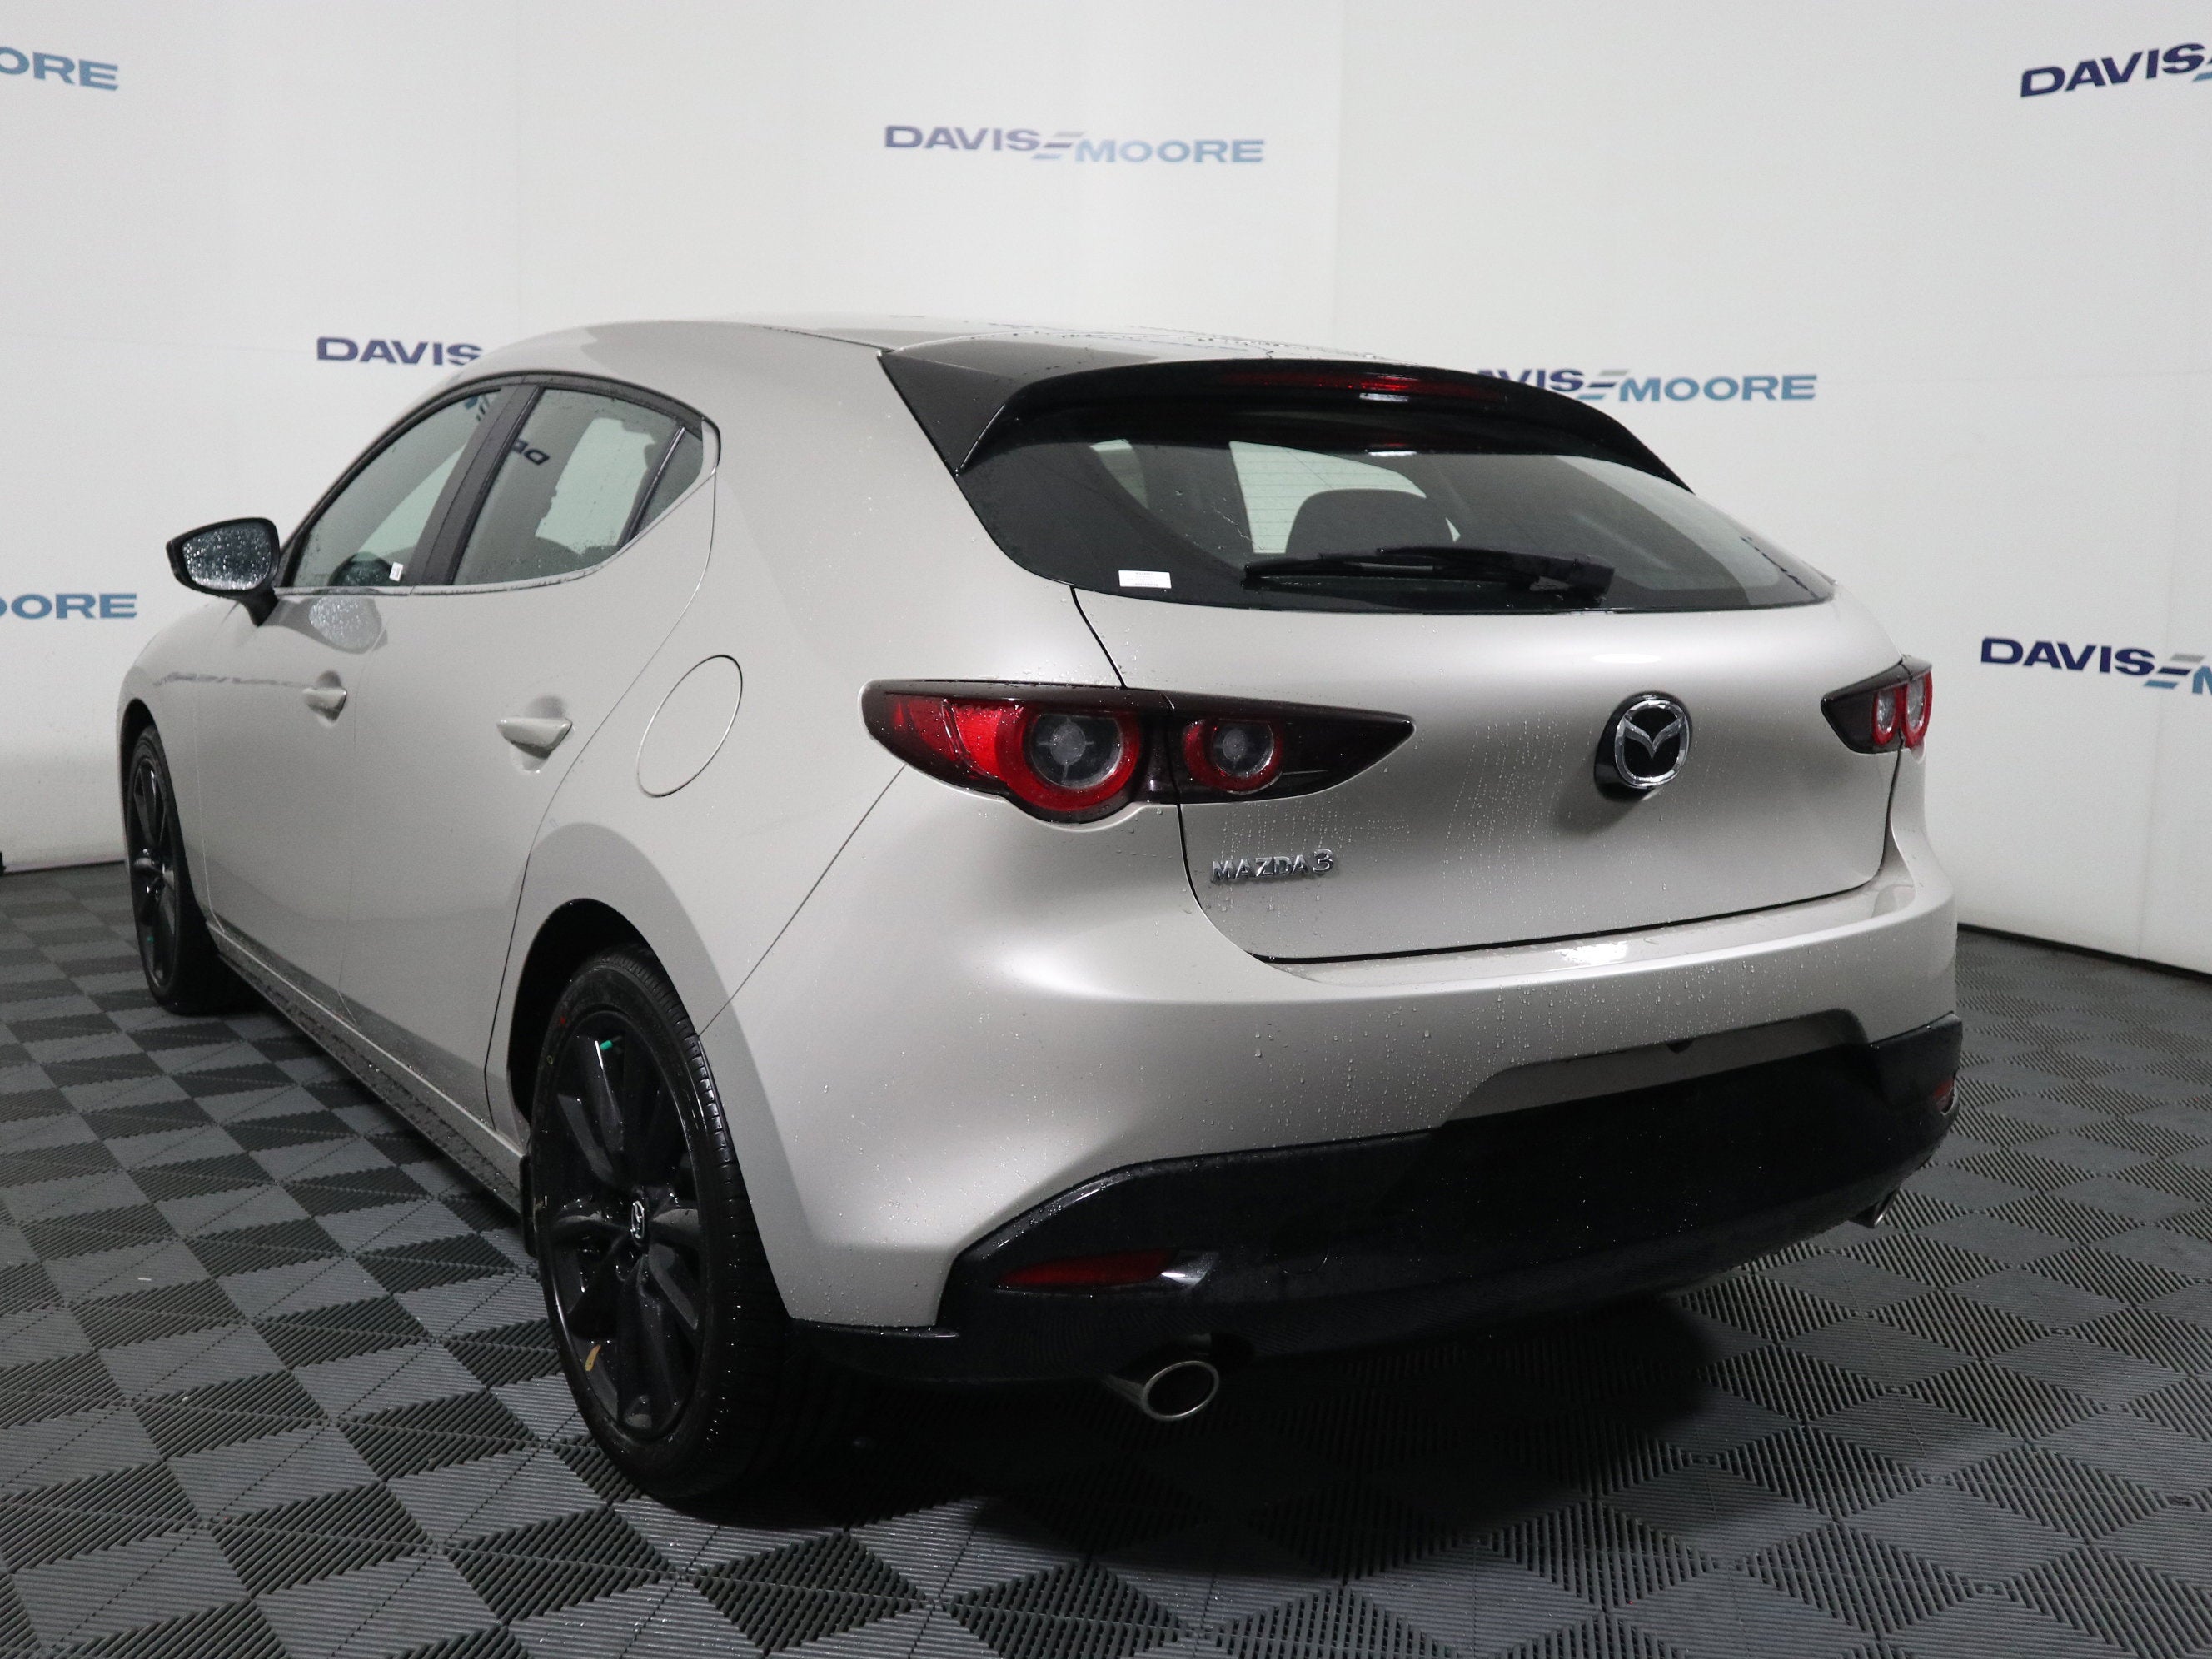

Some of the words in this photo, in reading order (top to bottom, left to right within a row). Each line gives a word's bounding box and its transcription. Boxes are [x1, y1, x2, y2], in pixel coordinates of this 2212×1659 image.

[0, 47, 118, 91] ORE
[2020, 43, 2205, 97] DAVIS
[884, 125, 1040, 152] DAVIS
[1075, 138, 1265, 163] MOORE
[317, 336, 482, 366] DAVIS
[1620, 374, 1817, 402] MOORE
[0, 593, 137, 620] ORE
[1980, 637, 2155, 676] DAVIS
